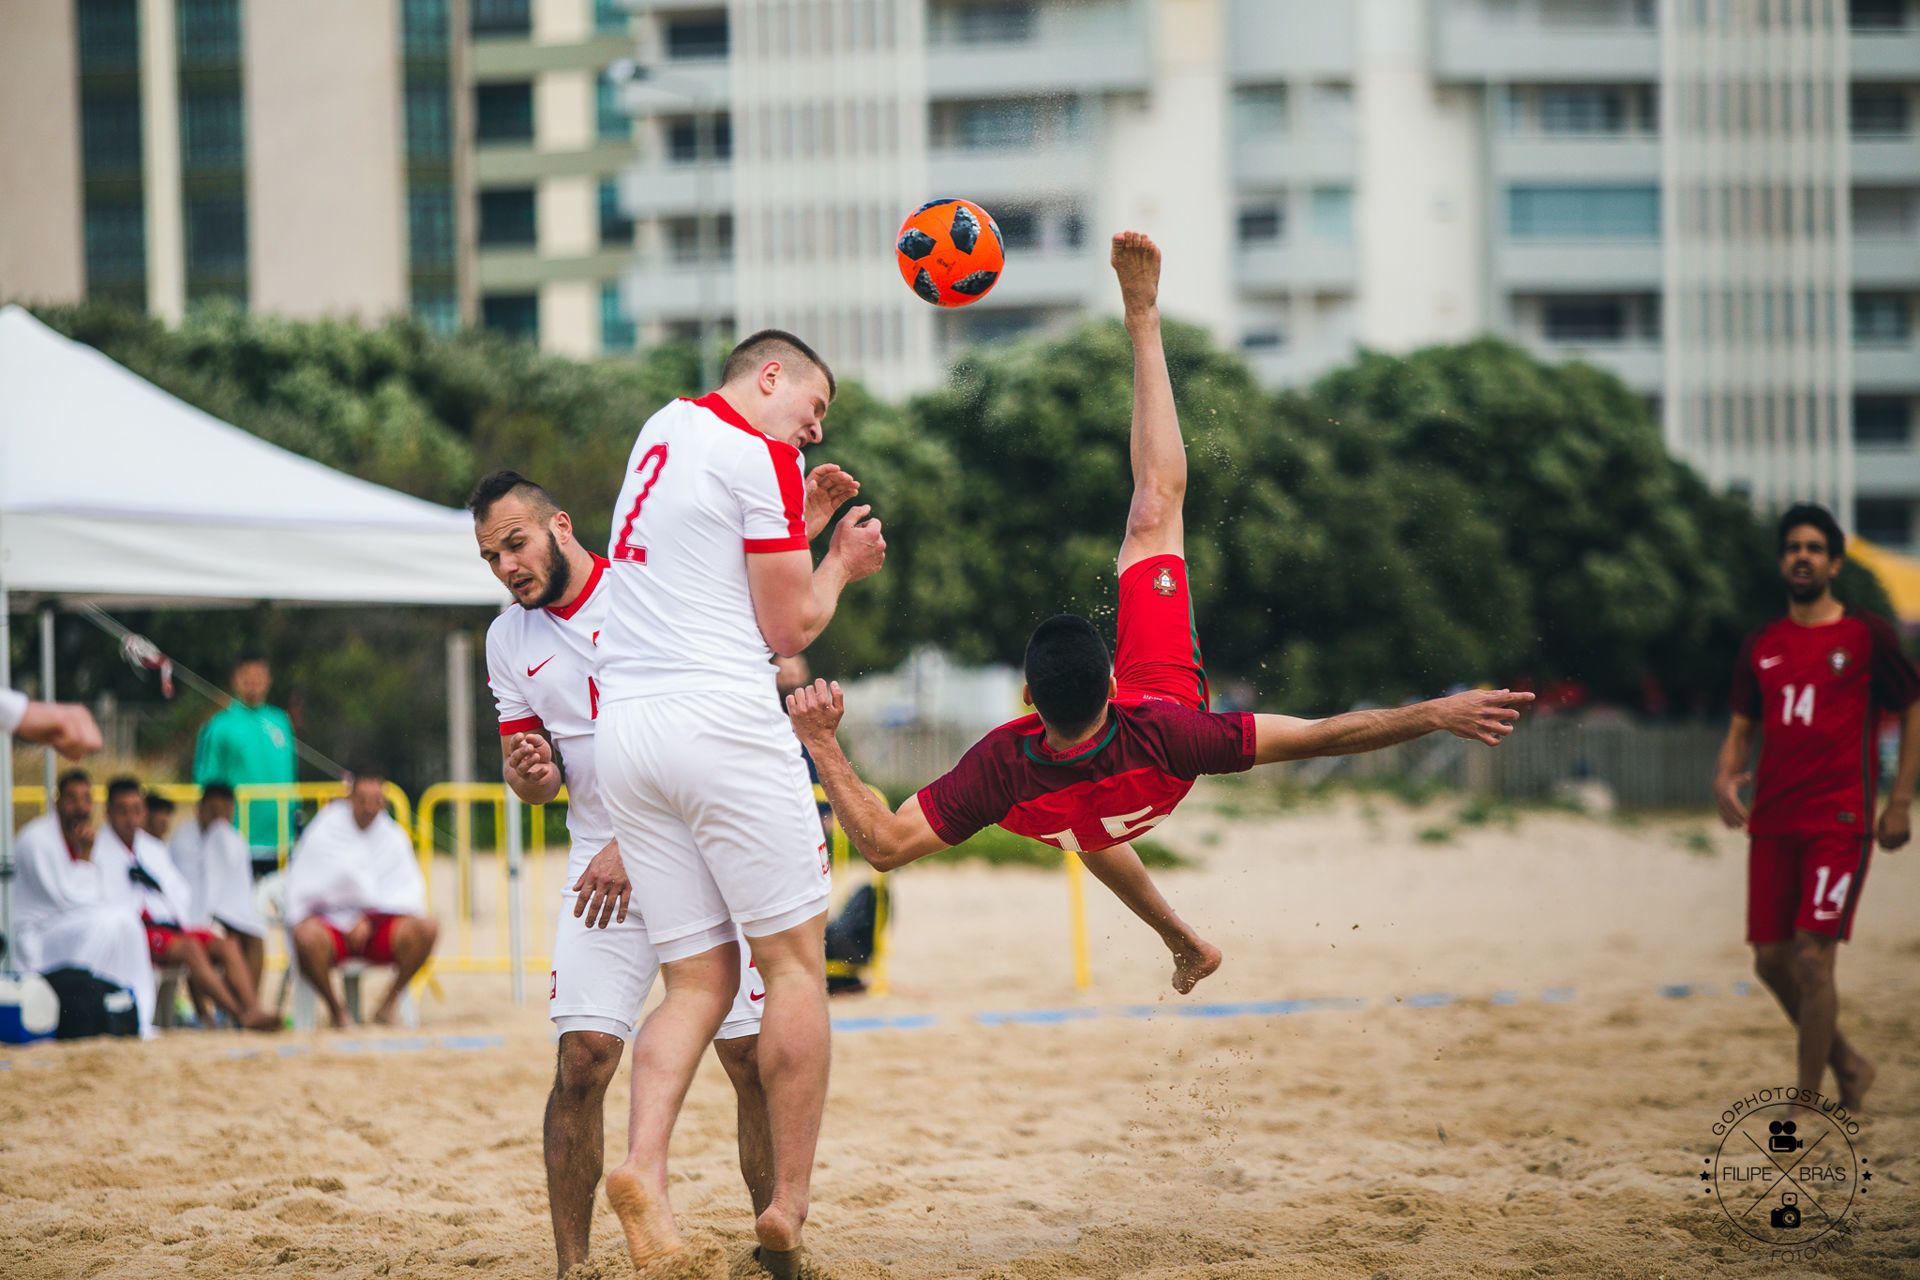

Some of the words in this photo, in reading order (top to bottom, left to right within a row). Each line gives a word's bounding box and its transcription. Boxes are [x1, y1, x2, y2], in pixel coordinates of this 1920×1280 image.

[612, 441, 669, 566] 2
[1782, 683, 1815, 726] 14
[1054, 740, 1094, 761] PORTUGAL
[1813, 866, 1852, 912] 14
